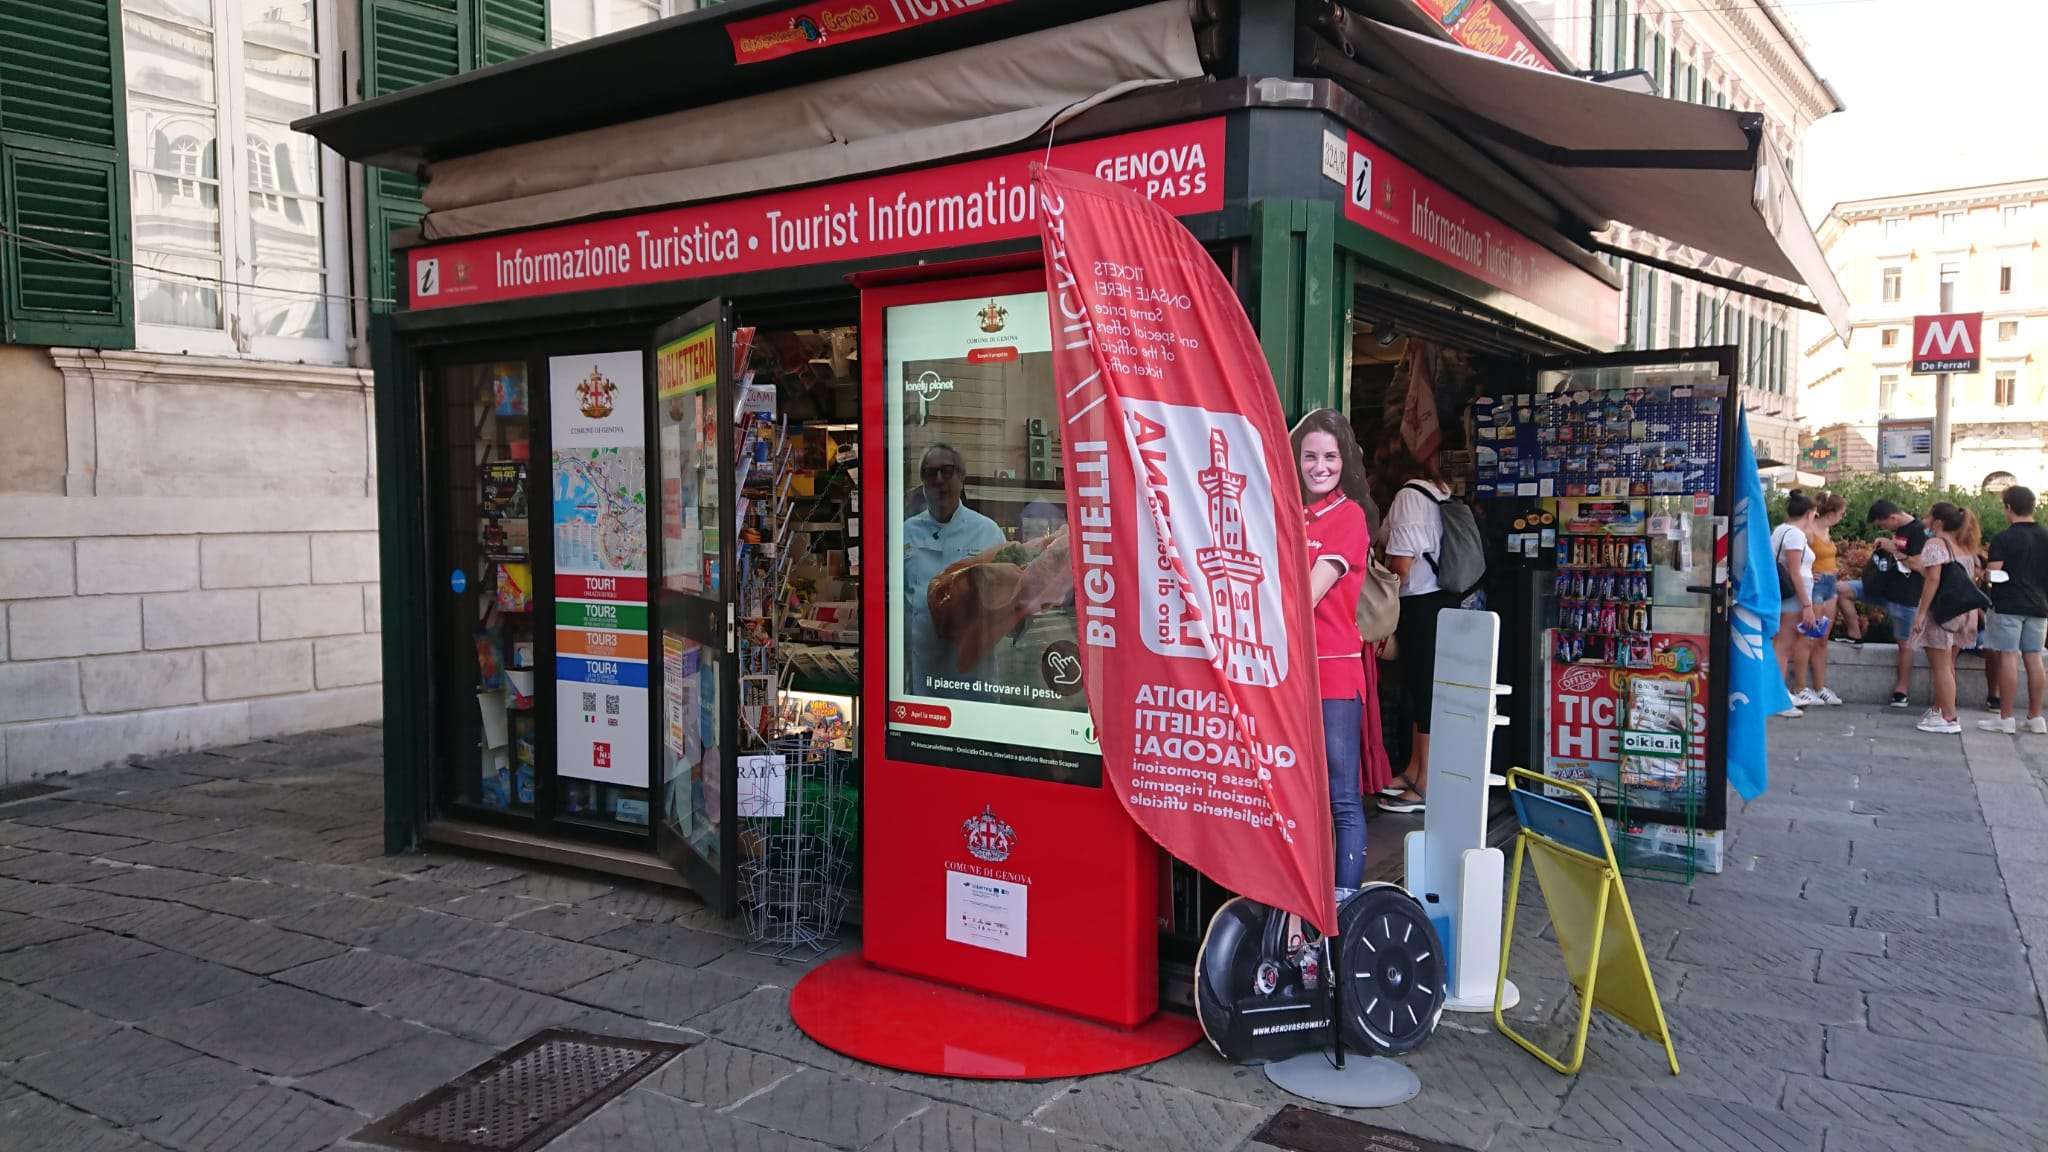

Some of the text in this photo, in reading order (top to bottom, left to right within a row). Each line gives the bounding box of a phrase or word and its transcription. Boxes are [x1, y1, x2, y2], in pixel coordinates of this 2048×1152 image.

[1096, 143, 1206, 181] GENOVA
[1147, 171, 1207, 201] PASS
[766, 202, 859, 255] Tourist
[1411, 187, 1483, 267] Informazione
[1485, 231, 1522, 284] Turistica
[496, 221, 739, 288] Informazione Turistica
[1919, 319, 1974, 355] M
[658, 336, 716, 391] BIGLIETTERIA
[1921, 360, 1971, 371] De Ferrari
[905, 379, 954, 393] lonely planet
[602, 426, 624, 434] GENOVA
[585, 577, 616, 592] TOUR1
[585, 604, 617, 618] TOUR2
[586, 633, 617, 646] TOUR3
[586, 661, 618, 675] TOUR4
[926, 675, 932, 687] il
[934, 677, 970, 690] piacere
[972, 679, 982, 691] di
[984, 681, 1021, 696] trovare
[1023, 685, 1030, 696] il
[944, 860, 1033, 885] COMUNE DI GENOVA
